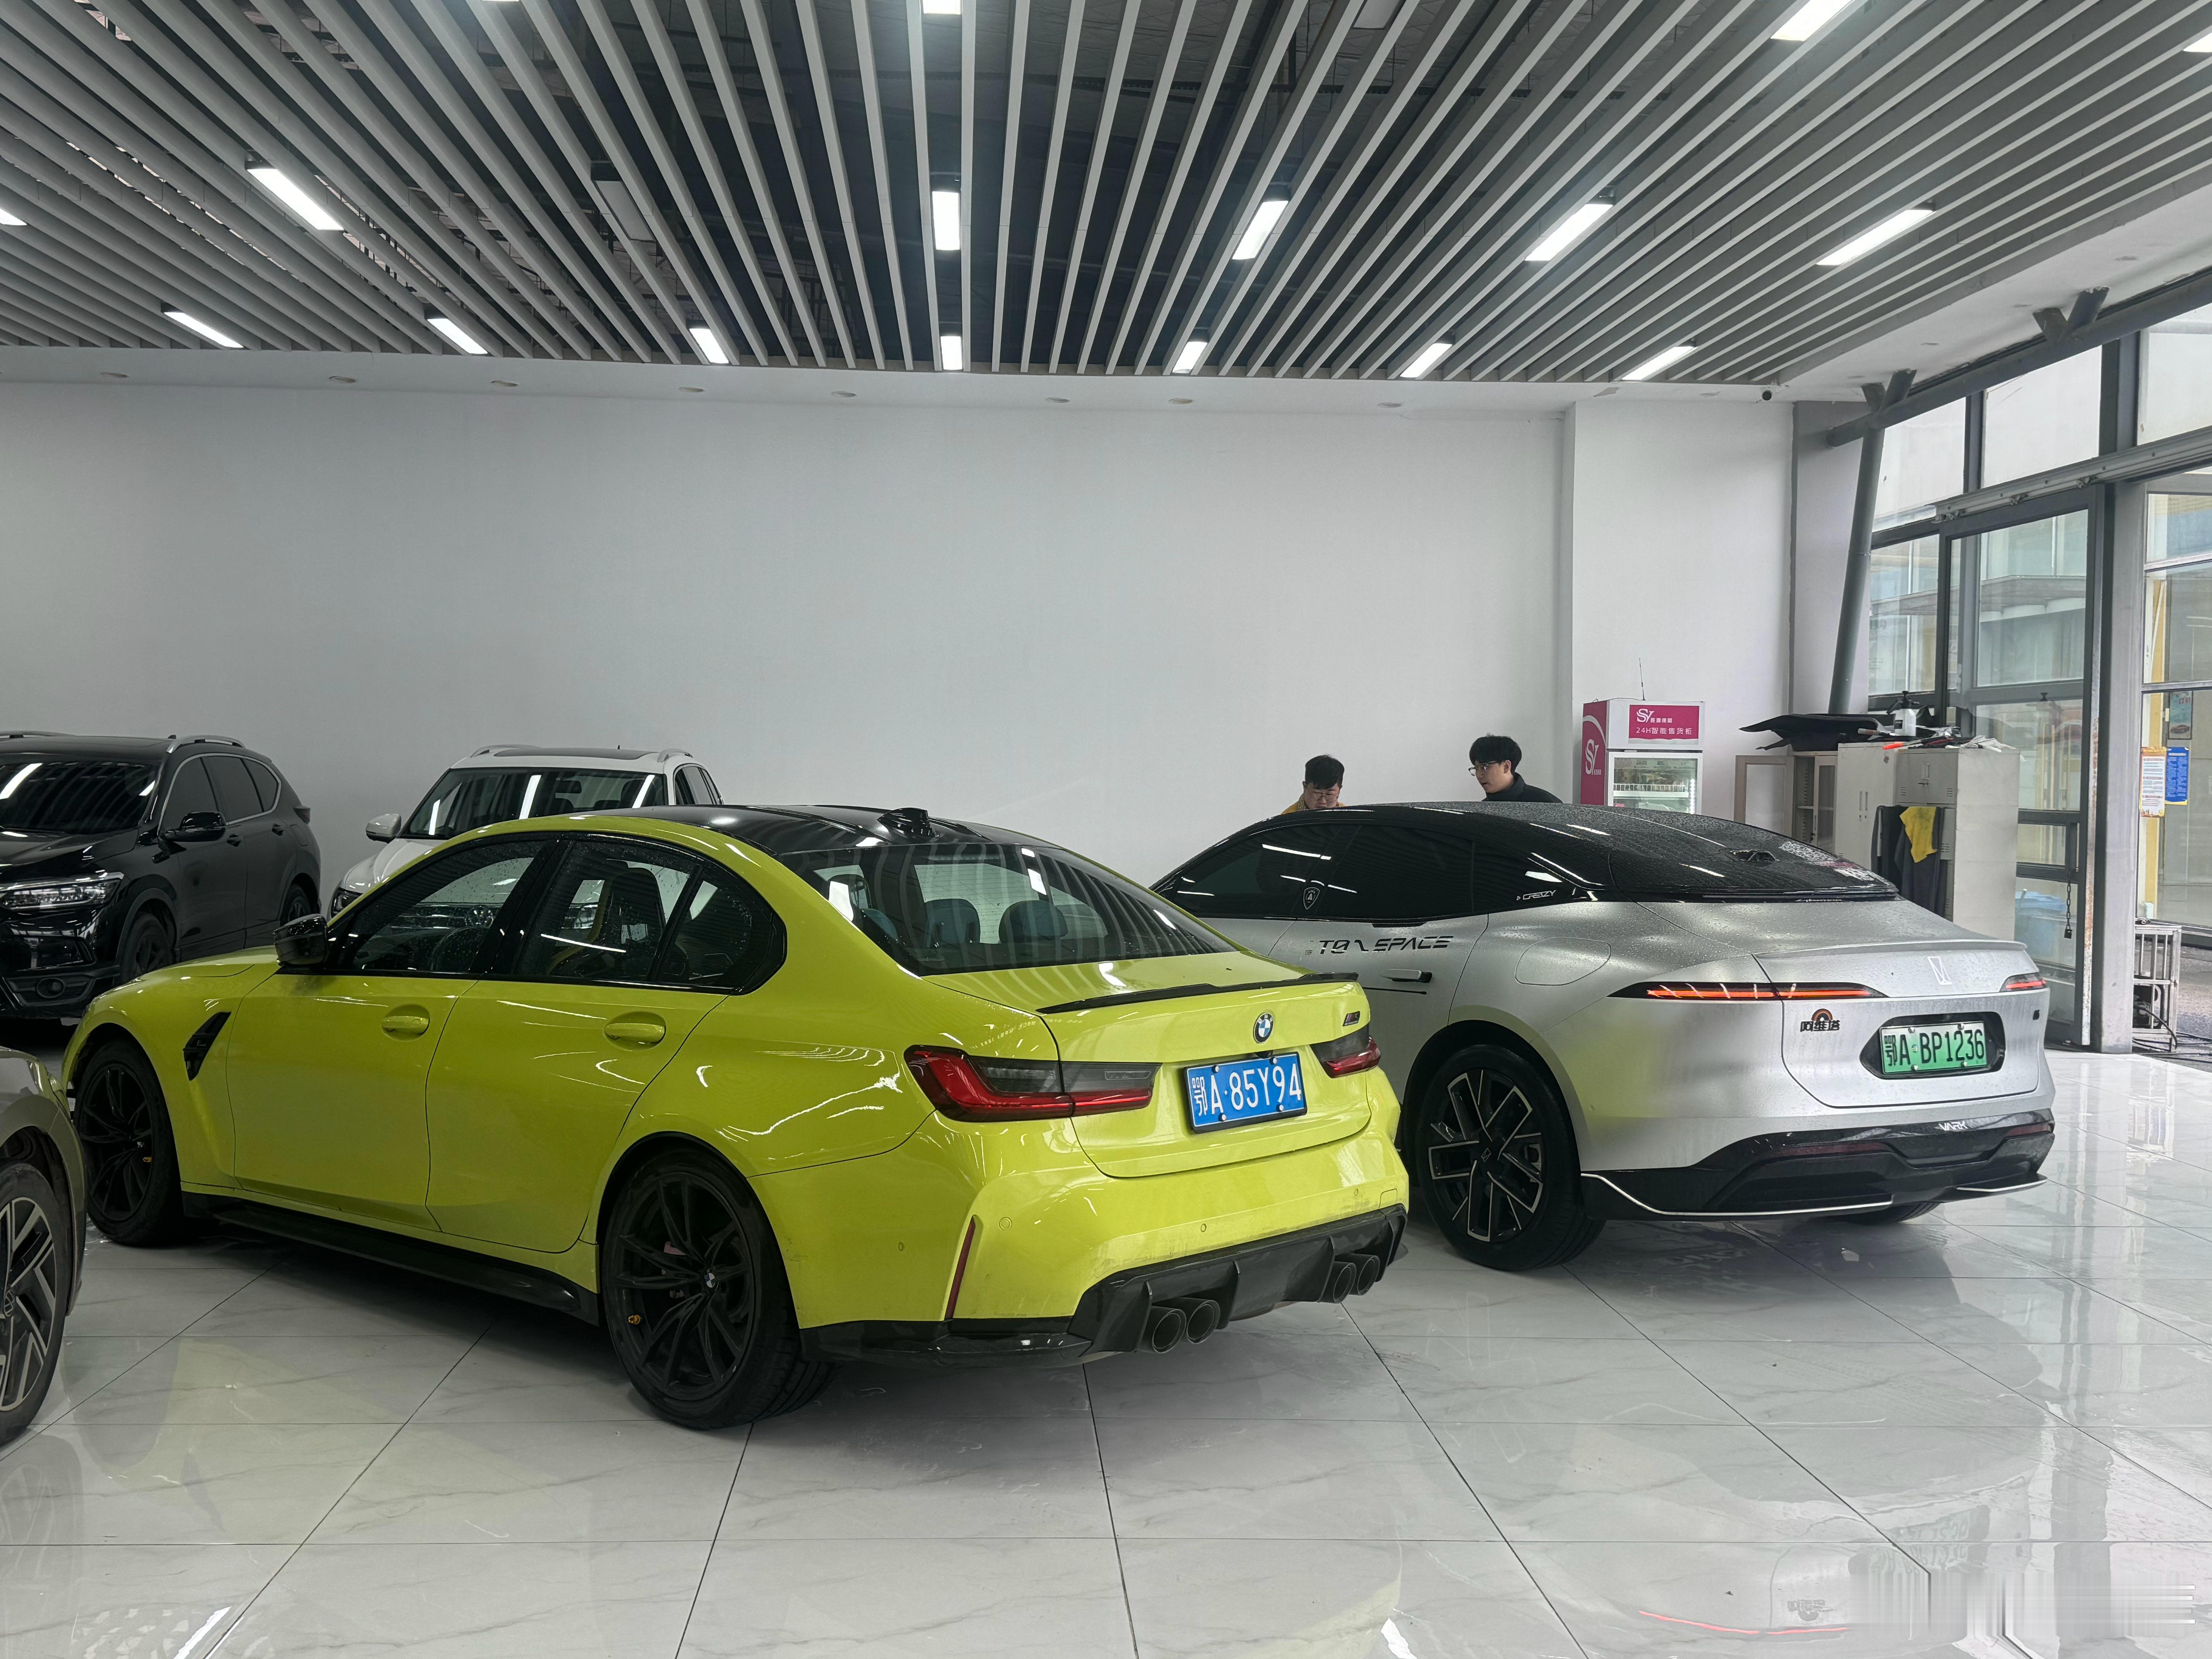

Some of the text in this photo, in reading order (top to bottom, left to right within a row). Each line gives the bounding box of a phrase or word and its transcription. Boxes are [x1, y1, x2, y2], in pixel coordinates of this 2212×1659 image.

[1372, 936, 1454, 953] SPACE
[1800, 1019, 1841, 1032] 阿维塔
